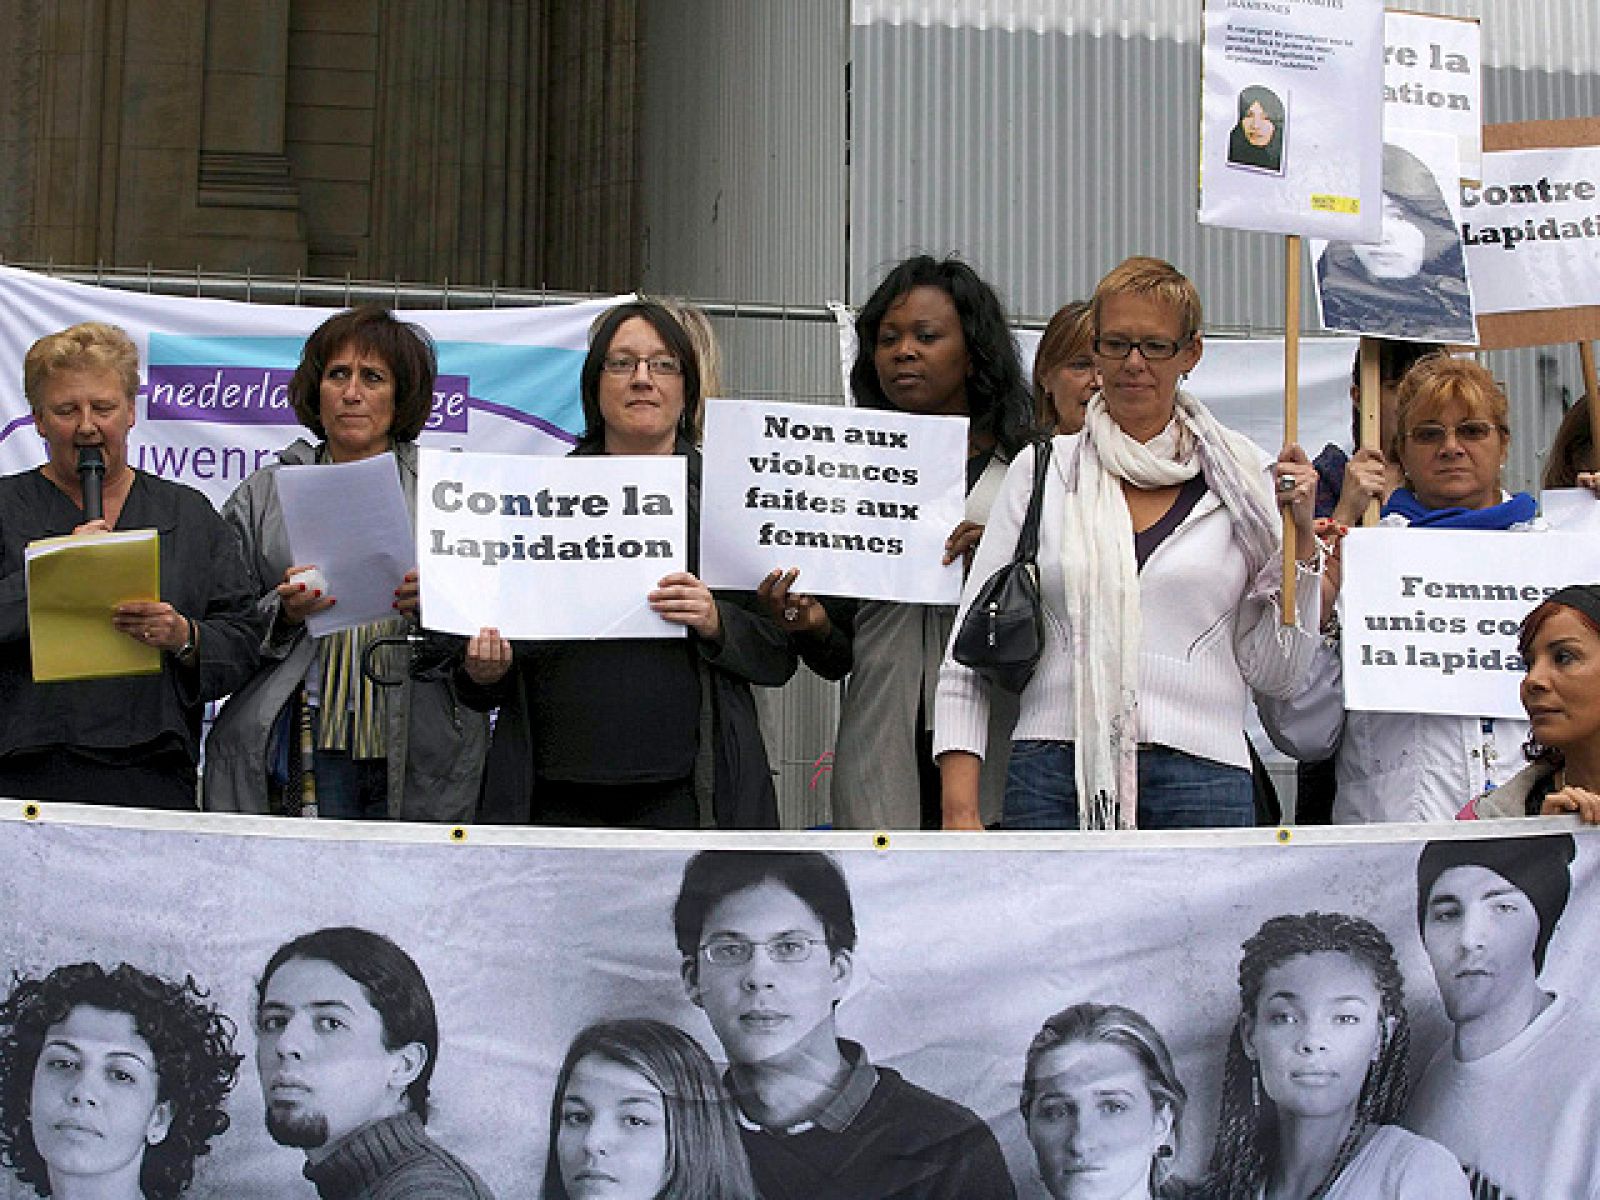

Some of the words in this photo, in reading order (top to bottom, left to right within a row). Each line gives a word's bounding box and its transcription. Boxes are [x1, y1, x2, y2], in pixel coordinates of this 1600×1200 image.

[1384, 45, 1418, 67] re
[1429, 44, 1471, 74] la
[1384, 82, 1471, 111] ation
[1460, 177, 1596, 208] Contre
[152, 370, 289, 409] nederla
[763, 414, 836, 443] Non
[844, 427, 909, 449] aux
[747, 451, 919, 486] violences
[431, 481, 611, 519] Contre
[621, 484, 674, 516] la
[744, 486, 847, 515] faites
[856, 499, 920, 521] aux
[430, 529, 674, 566] Lapidation
[758, 521, 904, 556] femmes
[1363, 609, 1467, 635] unies
[1476, 619, 1519, 636] co
[1361, 644, 1398, 667] la
[1404, 644, 1527, 676] lapida
